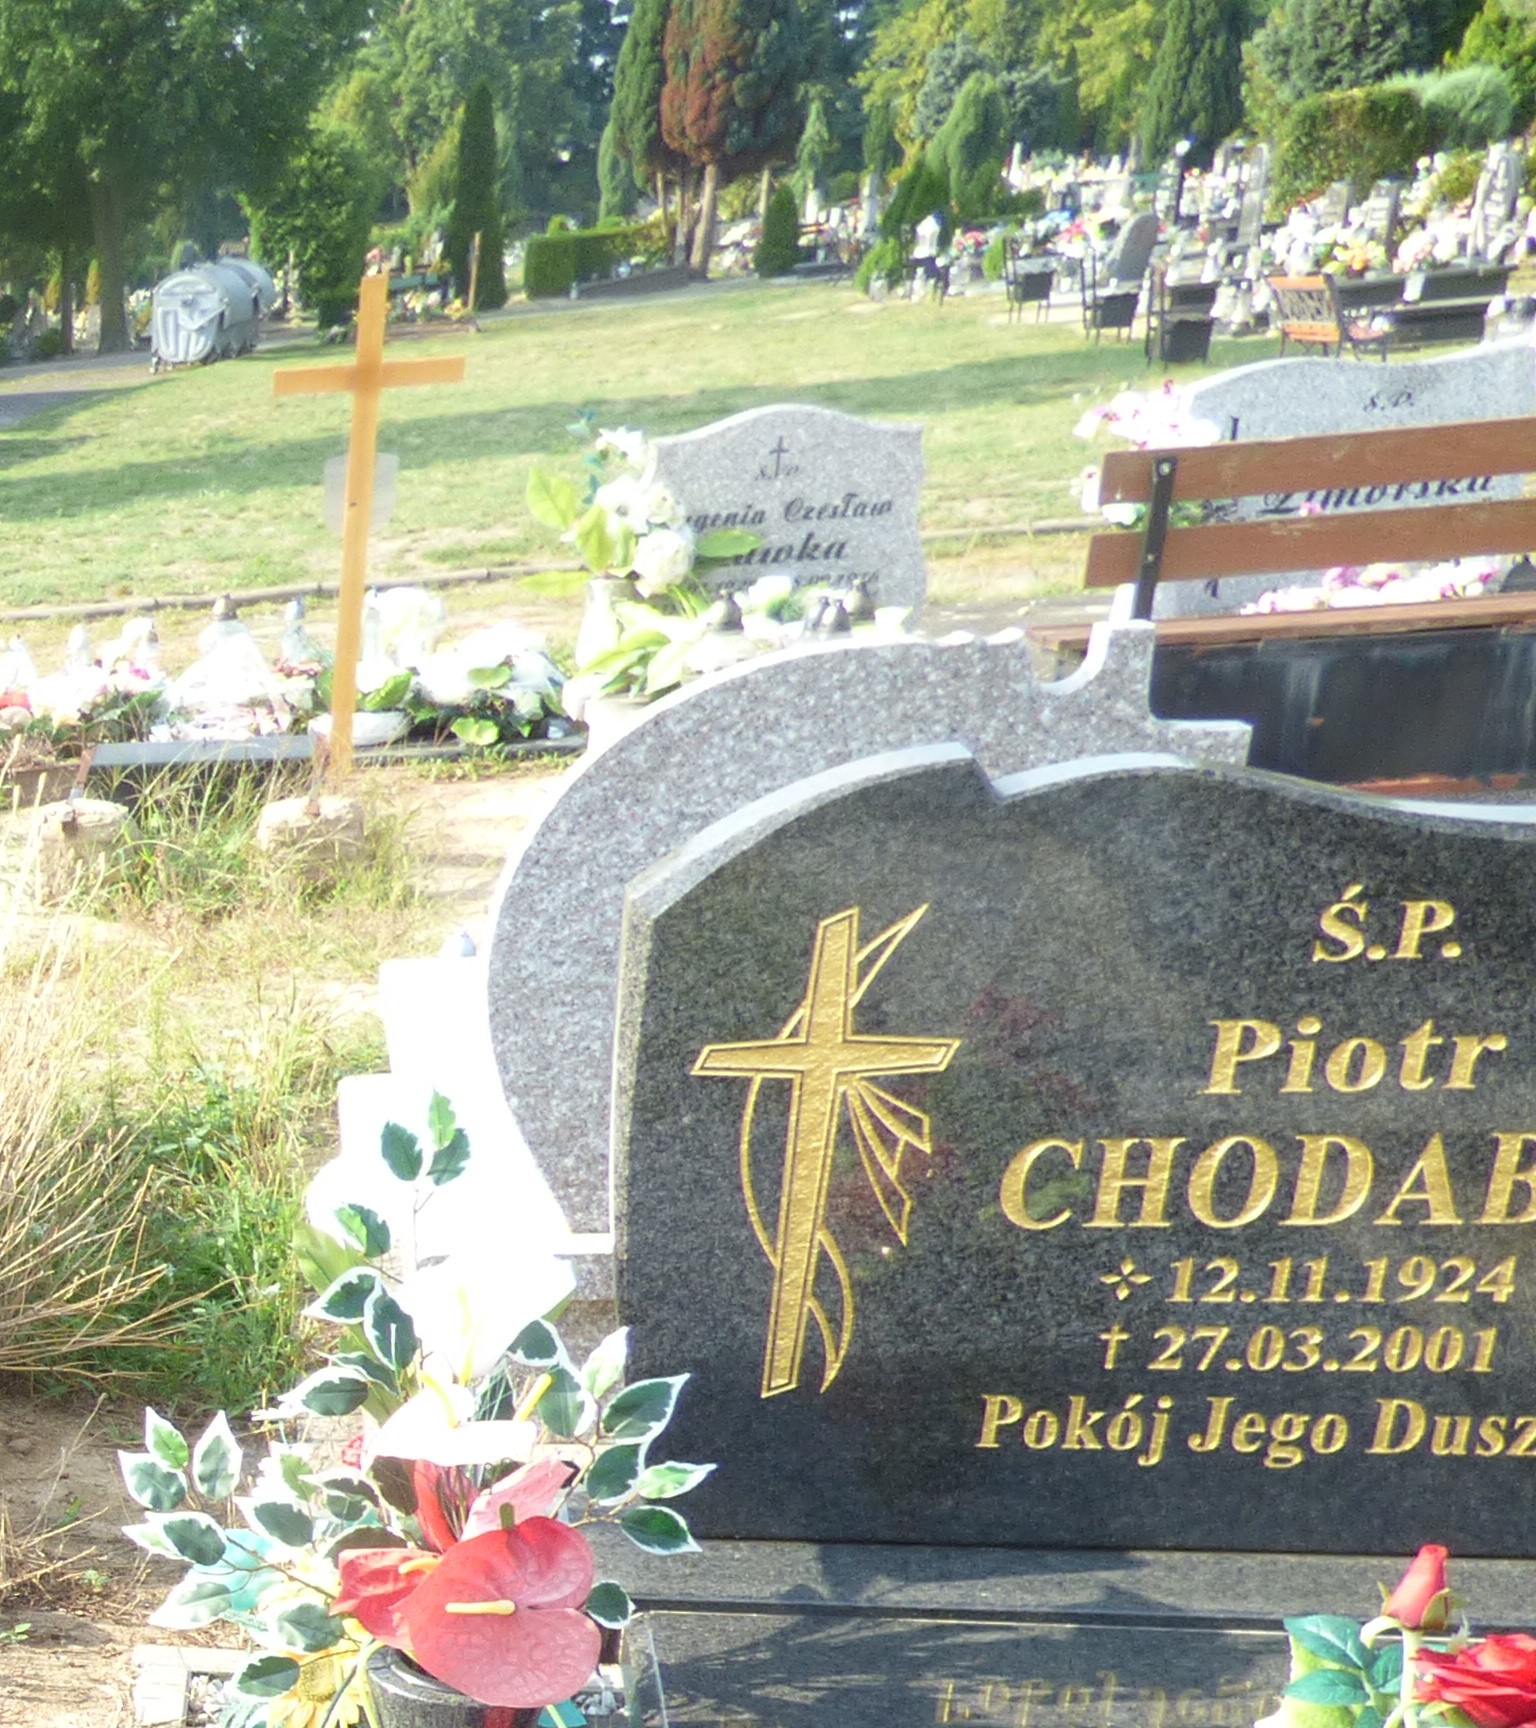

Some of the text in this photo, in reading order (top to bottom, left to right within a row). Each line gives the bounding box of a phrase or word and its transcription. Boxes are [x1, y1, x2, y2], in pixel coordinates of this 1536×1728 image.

[1312, 884, 1462, 962] Ś.P.
[1196, 1016, 1507, 1094] Piotr
[1166, 1255, 1517, 1304] 12.11.1924
[1147, 1325, 1498, 1372] 27.03.2001
[975, 1393, 1174, 1467] Pokój
[1188, 1396, 1350, 1468] Jego
